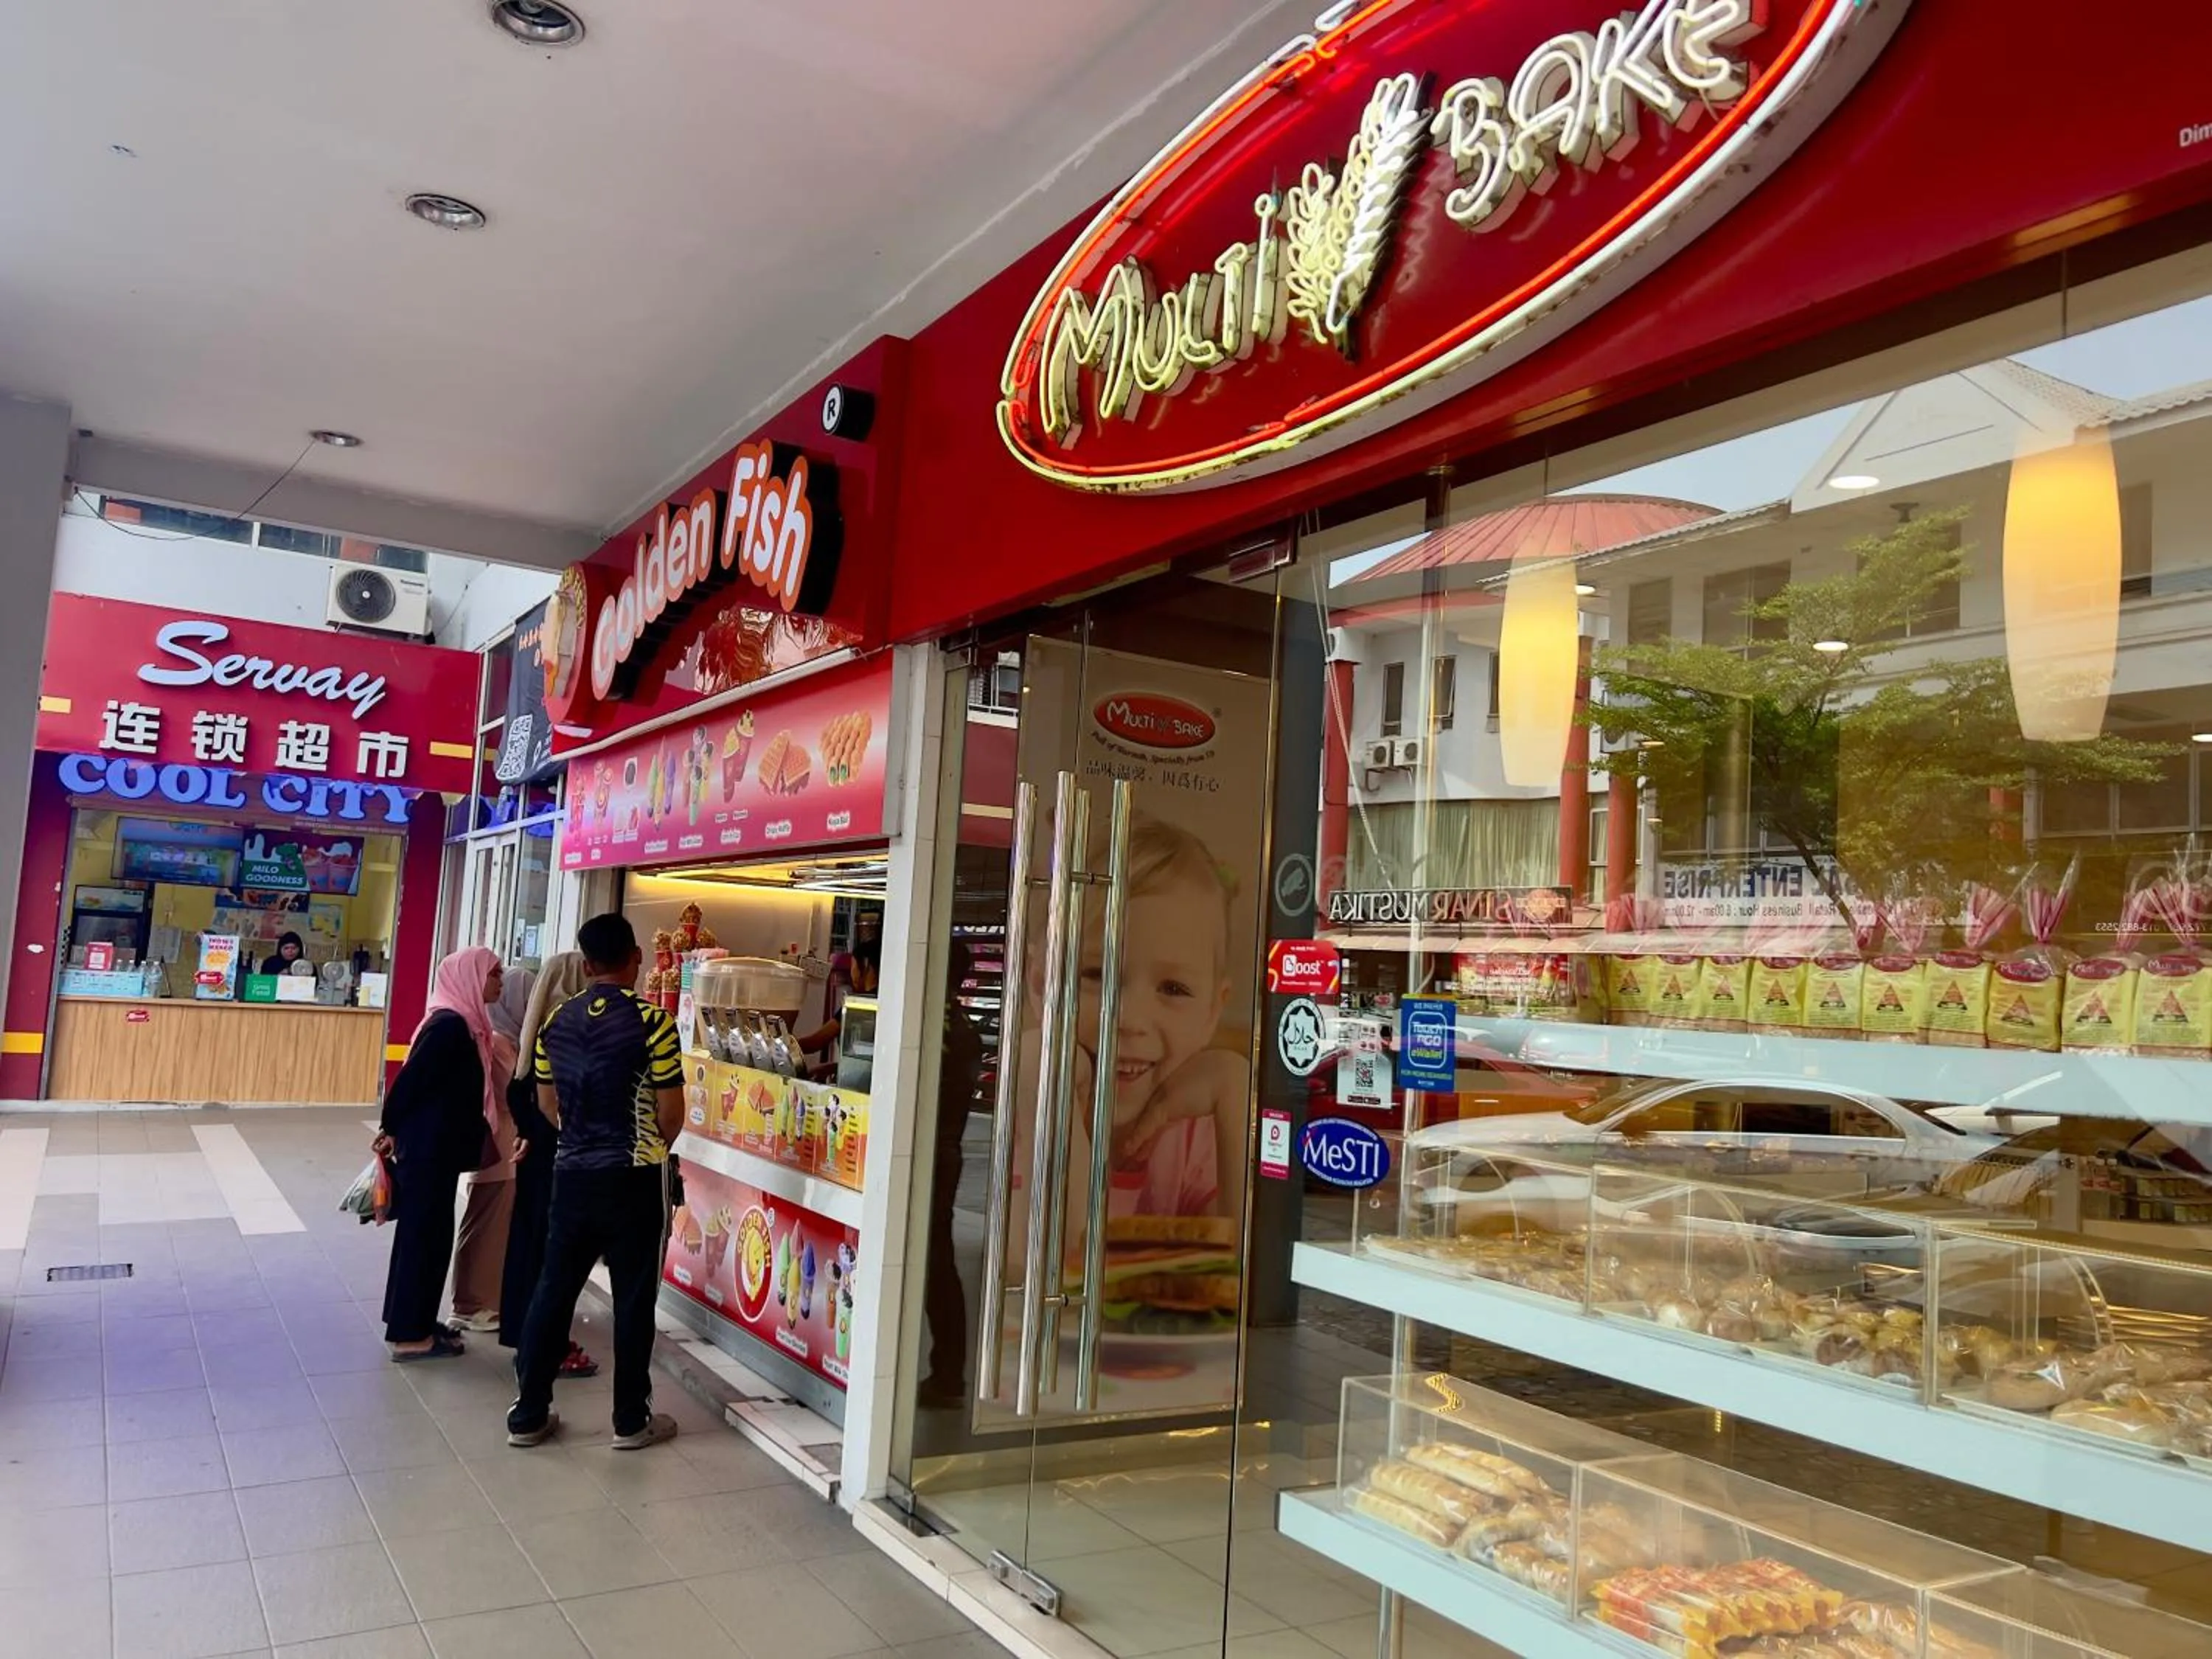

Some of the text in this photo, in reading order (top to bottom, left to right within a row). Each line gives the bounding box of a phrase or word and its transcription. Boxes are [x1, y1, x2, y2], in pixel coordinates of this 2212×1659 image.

[594, 441, 811, 698] Golden Fish
[99, 700, 410, 779] 连锁超市
[58, 753, 412, 824] COOL CITY
[246, 874, 304, 885] GOODNESS
[251, 864, 279, 874] MILO
[1283, 954, 1322, 977] Boost
[1302, 1130, 1381, 1178] MeSTI
